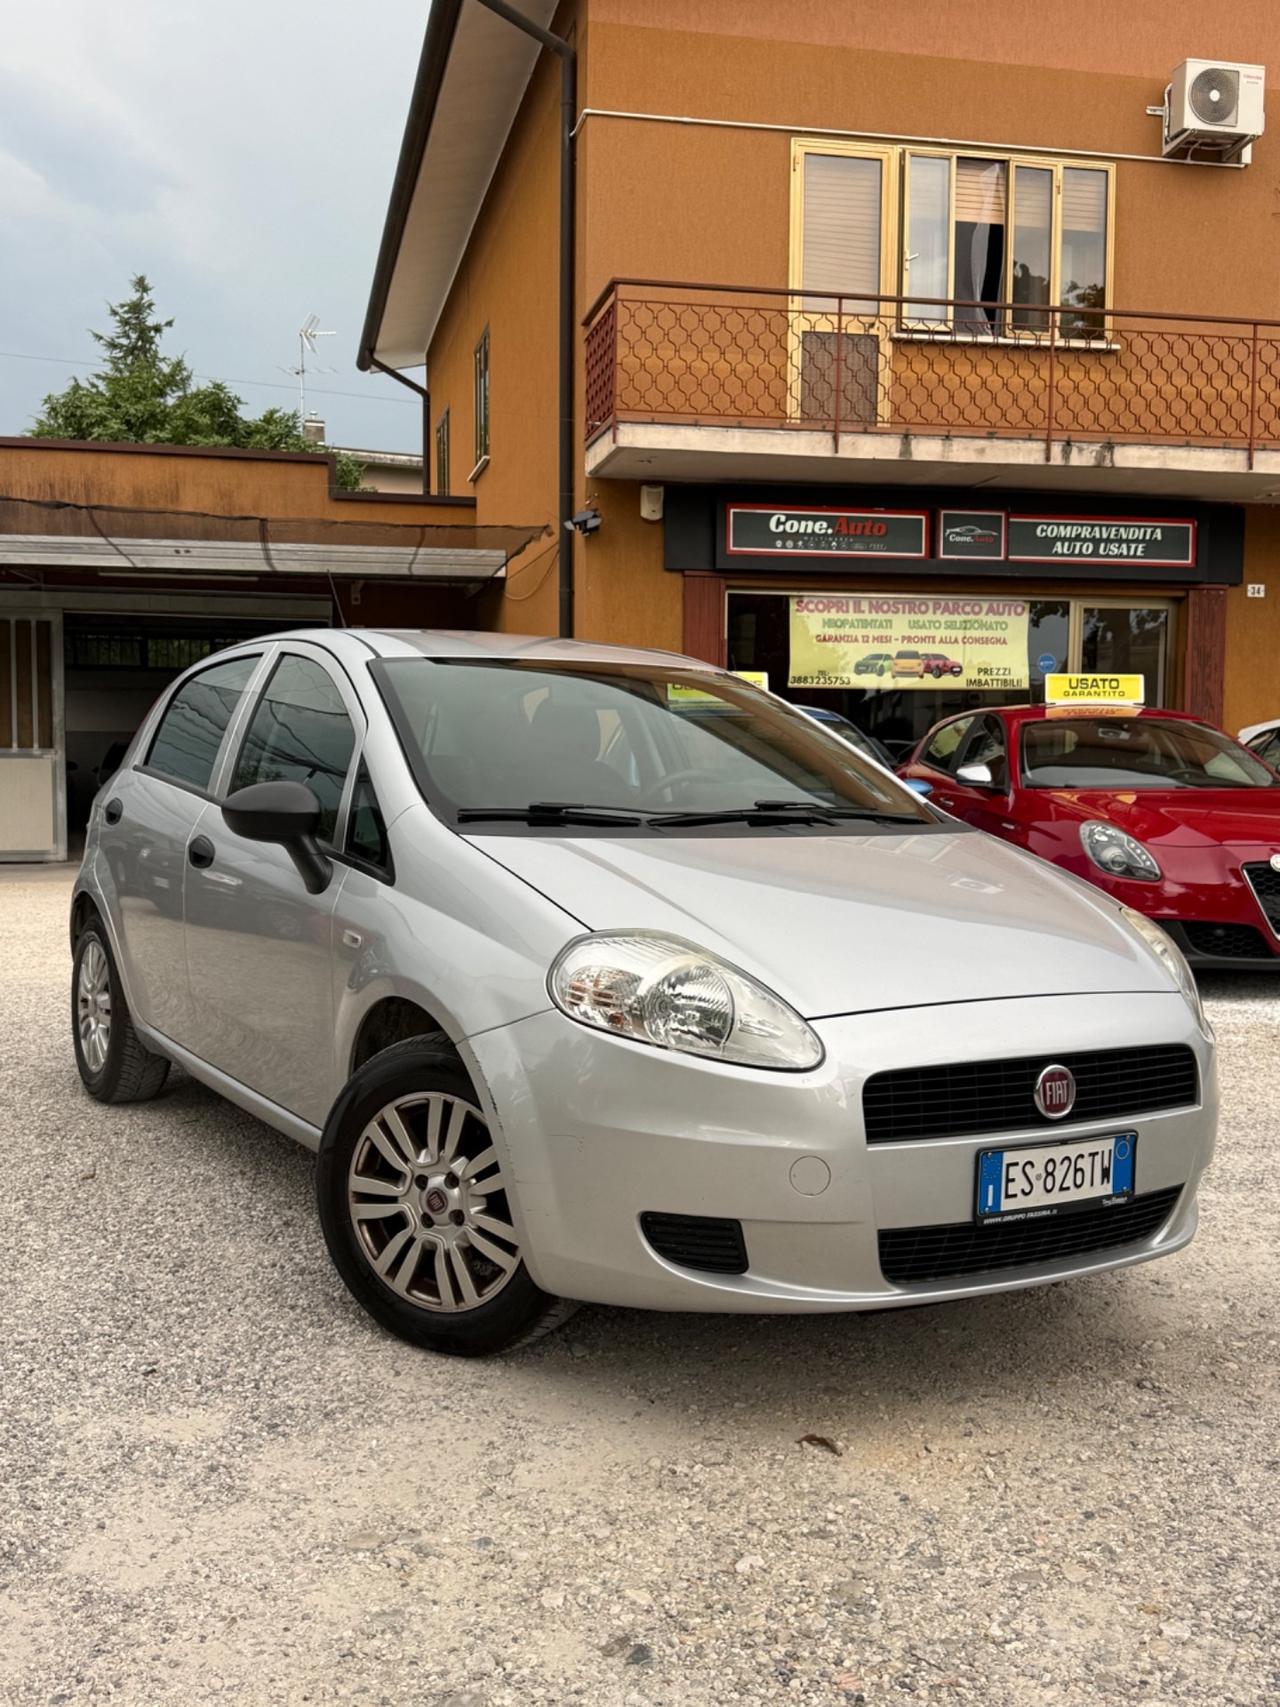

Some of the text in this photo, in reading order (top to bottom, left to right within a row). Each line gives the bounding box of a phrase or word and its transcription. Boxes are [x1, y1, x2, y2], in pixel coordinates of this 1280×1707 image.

[769, 514, 887, 536] Cone.Auto
[1035, 524, 1162, 540] COMPRAVENDITA
[1052, 541, 1146, 556] AUTO USATE
[796, 599, 1025, 616] SCOPRI IL NOSTRO PARCO AUTO
[908, 619, 942, 630] USATO
[944, 620, 1008, 631] SELEZIONATO
[815, 634, 859, 643] GARANZIA
[861, 635, 870, 643] 12
[872, 635, 892, 643] MESI
[901, 635, 936, 644] PRONTE
[938, 636, 959, 644] ALLA
[961, 636, 1008, 645] CONSEGNA
[977, 667, 1011, 676] PREZZI
[790, 676, 851, 685] 3883235753
[1069, 678, 1120, 690] USATO
[1045, 1080, 1068, 1105] FIAT
